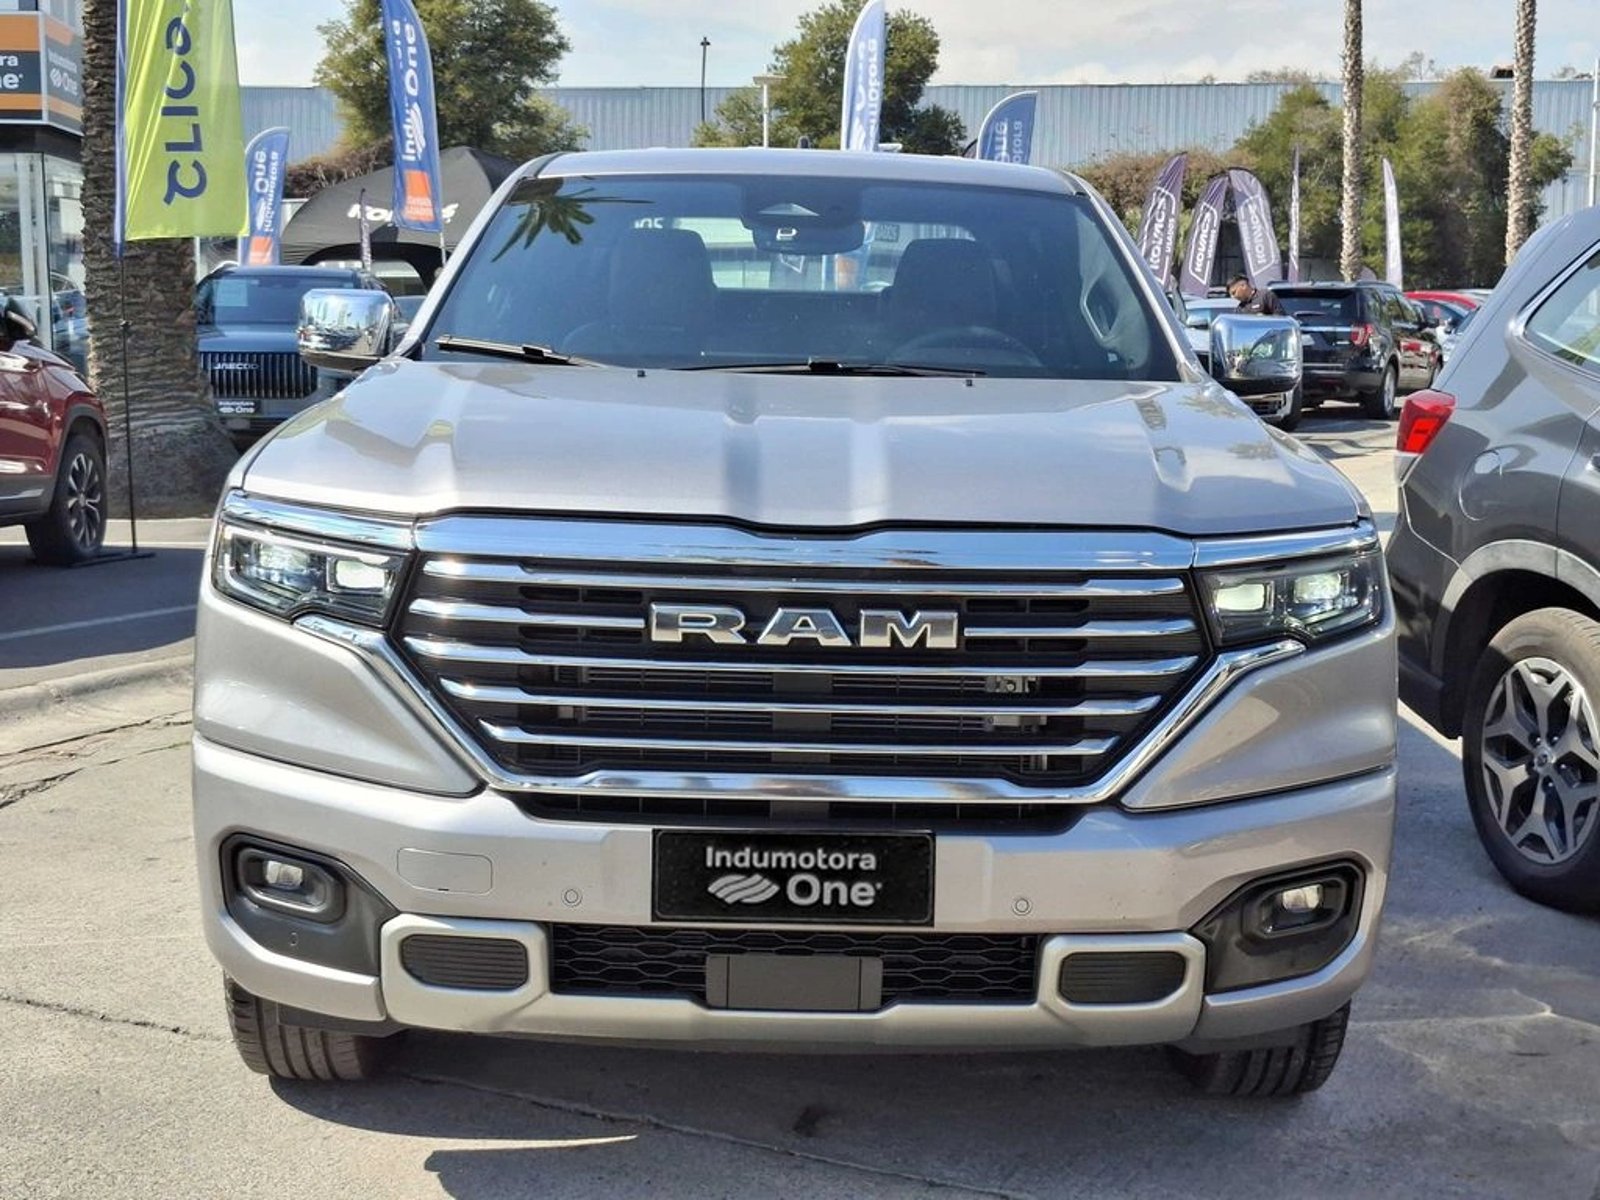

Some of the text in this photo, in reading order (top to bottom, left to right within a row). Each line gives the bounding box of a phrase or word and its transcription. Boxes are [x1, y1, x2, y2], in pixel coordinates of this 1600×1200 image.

[404, 23, 419, 97] One
[651, 602, 958, 648] RAM
[706, 846, 877, 870] Indumotora
[786, 873, 877, 906] One
